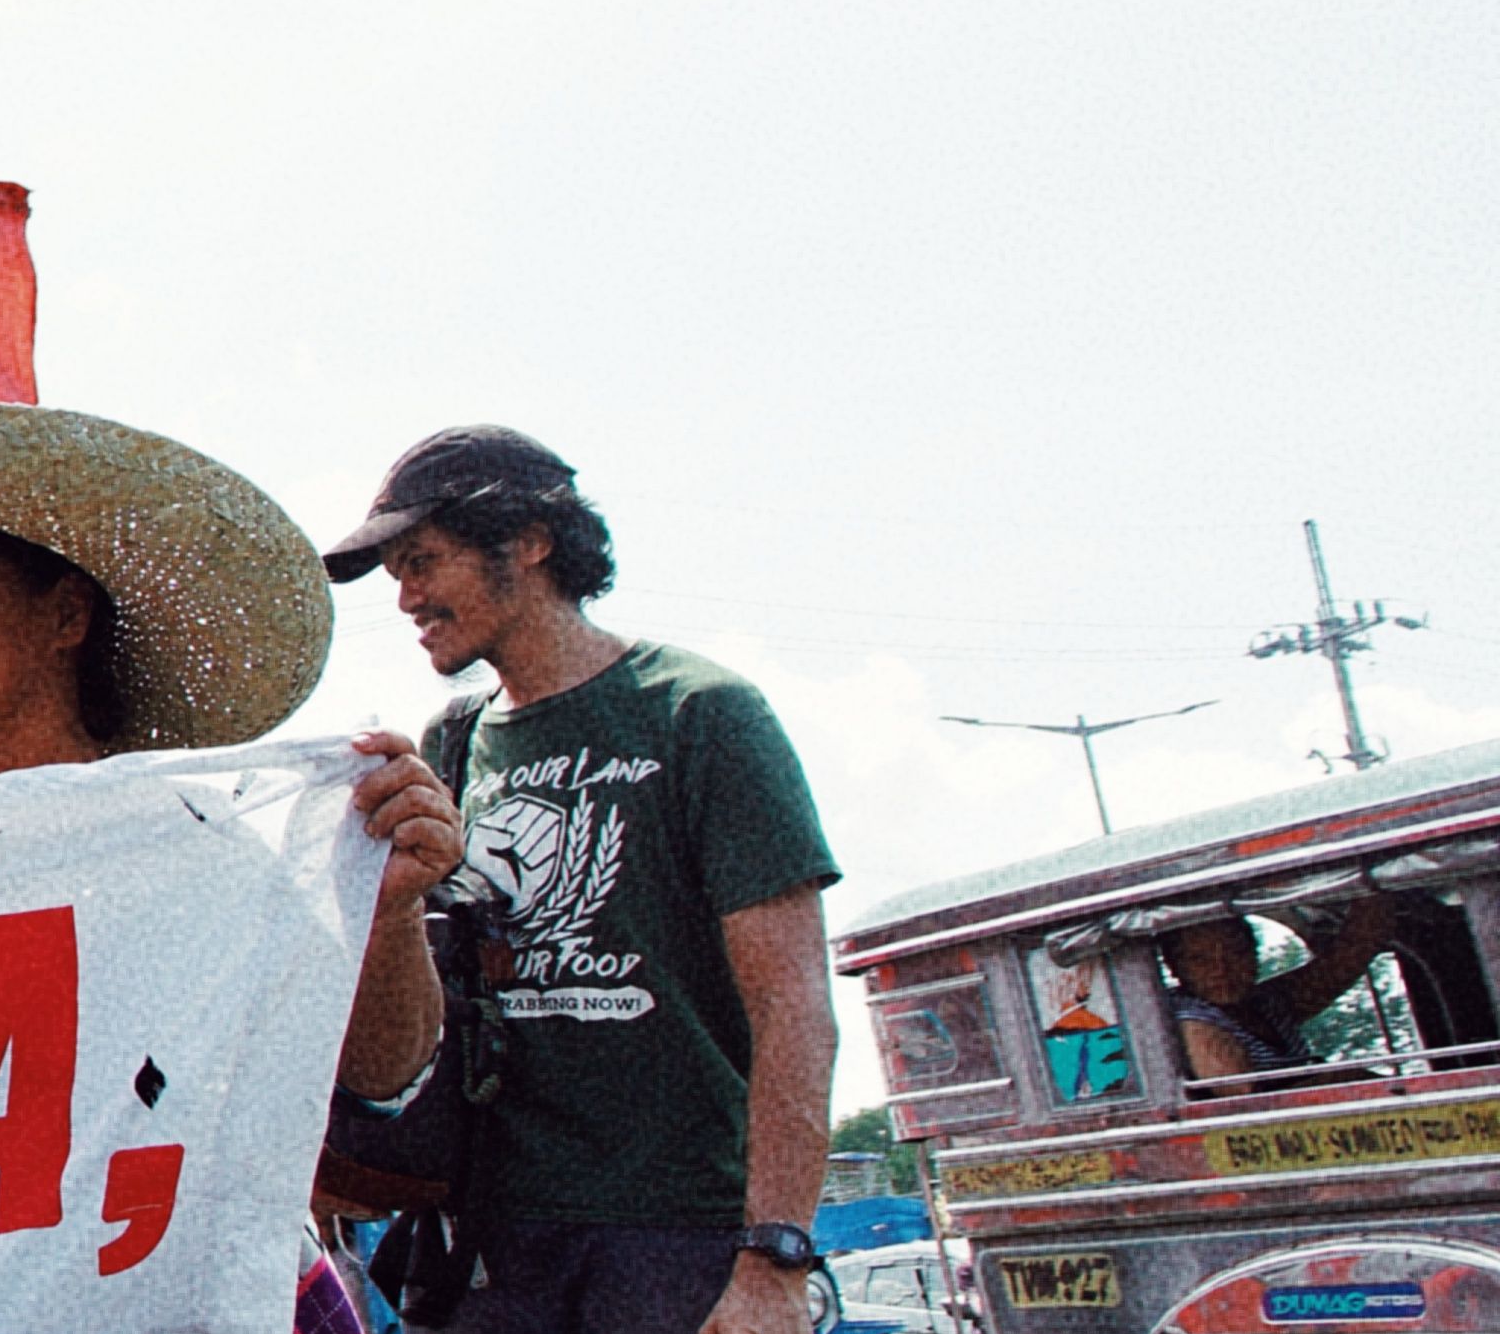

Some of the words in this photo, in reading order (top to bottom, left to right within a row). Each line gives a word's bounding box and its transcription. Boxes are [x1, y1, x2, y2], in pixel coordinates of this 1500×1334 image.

[511, 755, 570, 789] OUR
[515, 949, 550, 985] UR
[583, 997, 643, 1011] NOW!
